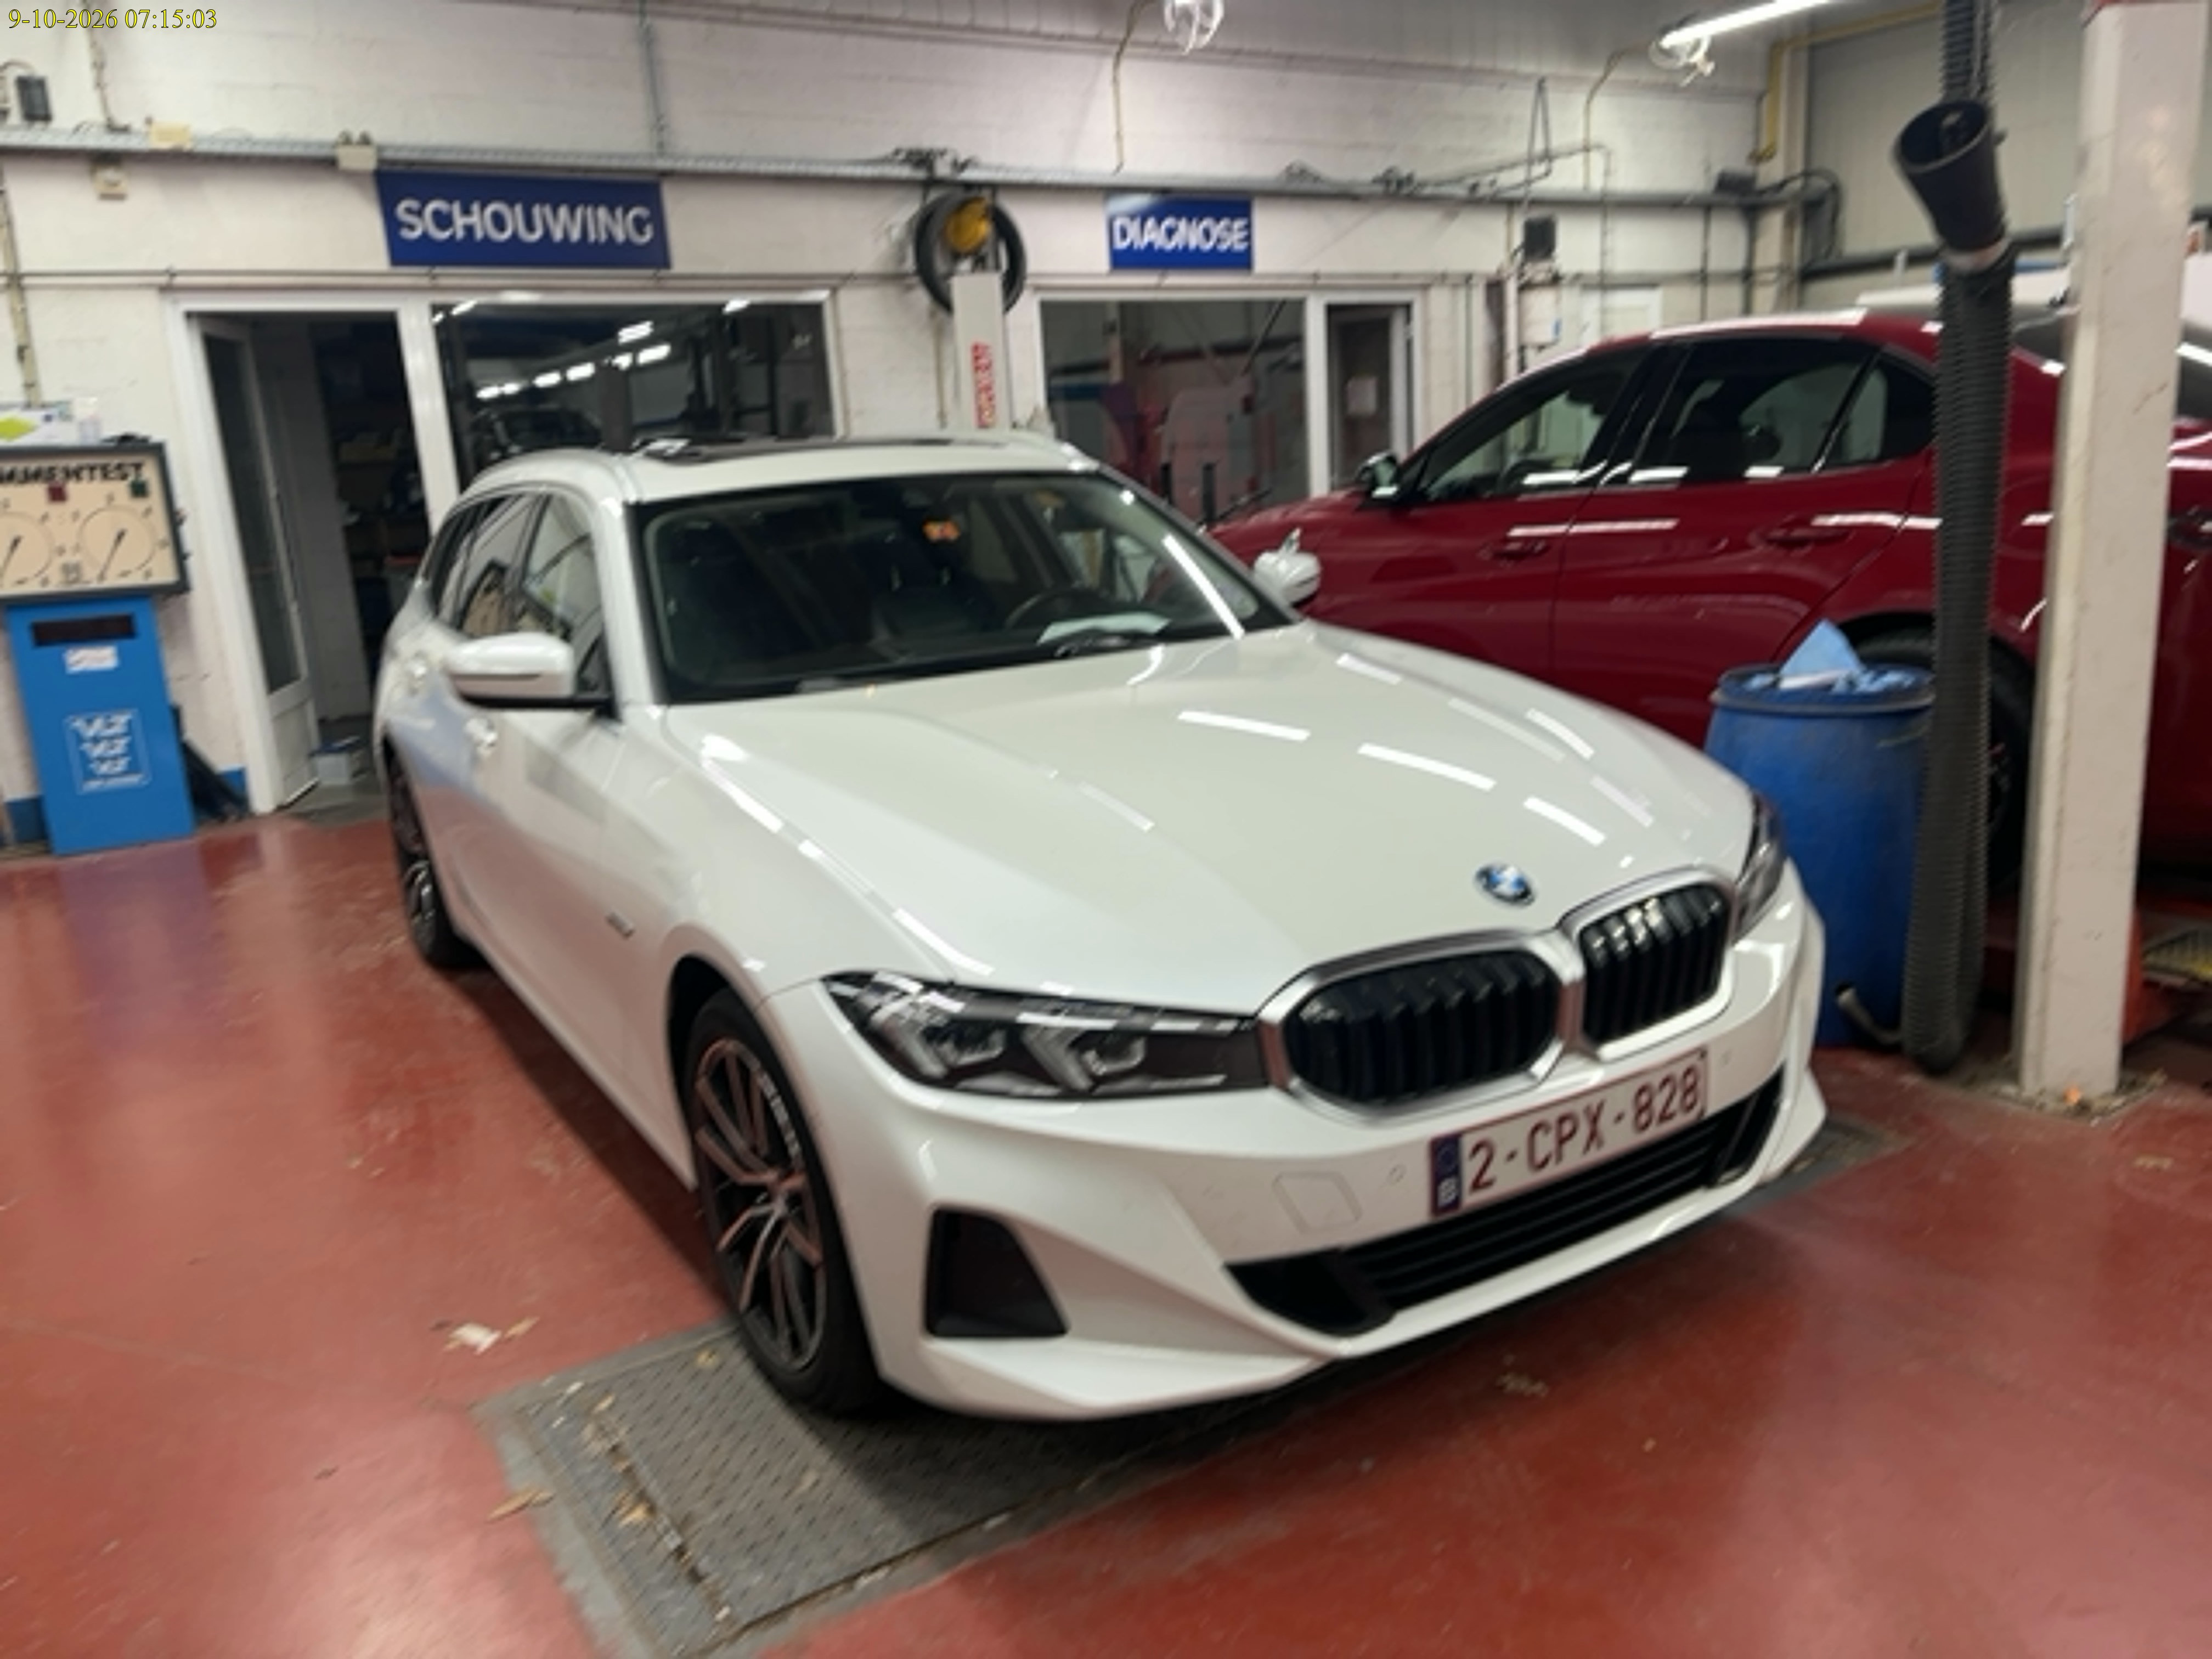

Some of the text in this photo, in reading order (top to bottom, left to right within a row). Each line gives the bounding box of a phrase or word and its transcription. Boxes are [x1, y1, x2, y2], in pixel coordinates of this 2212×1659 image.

[394, 198, 654, 245] SCHOUWING
[1112, 216, 1249, 252] DIAGNOSE
[1437, 1177, 1457, 1206] B
